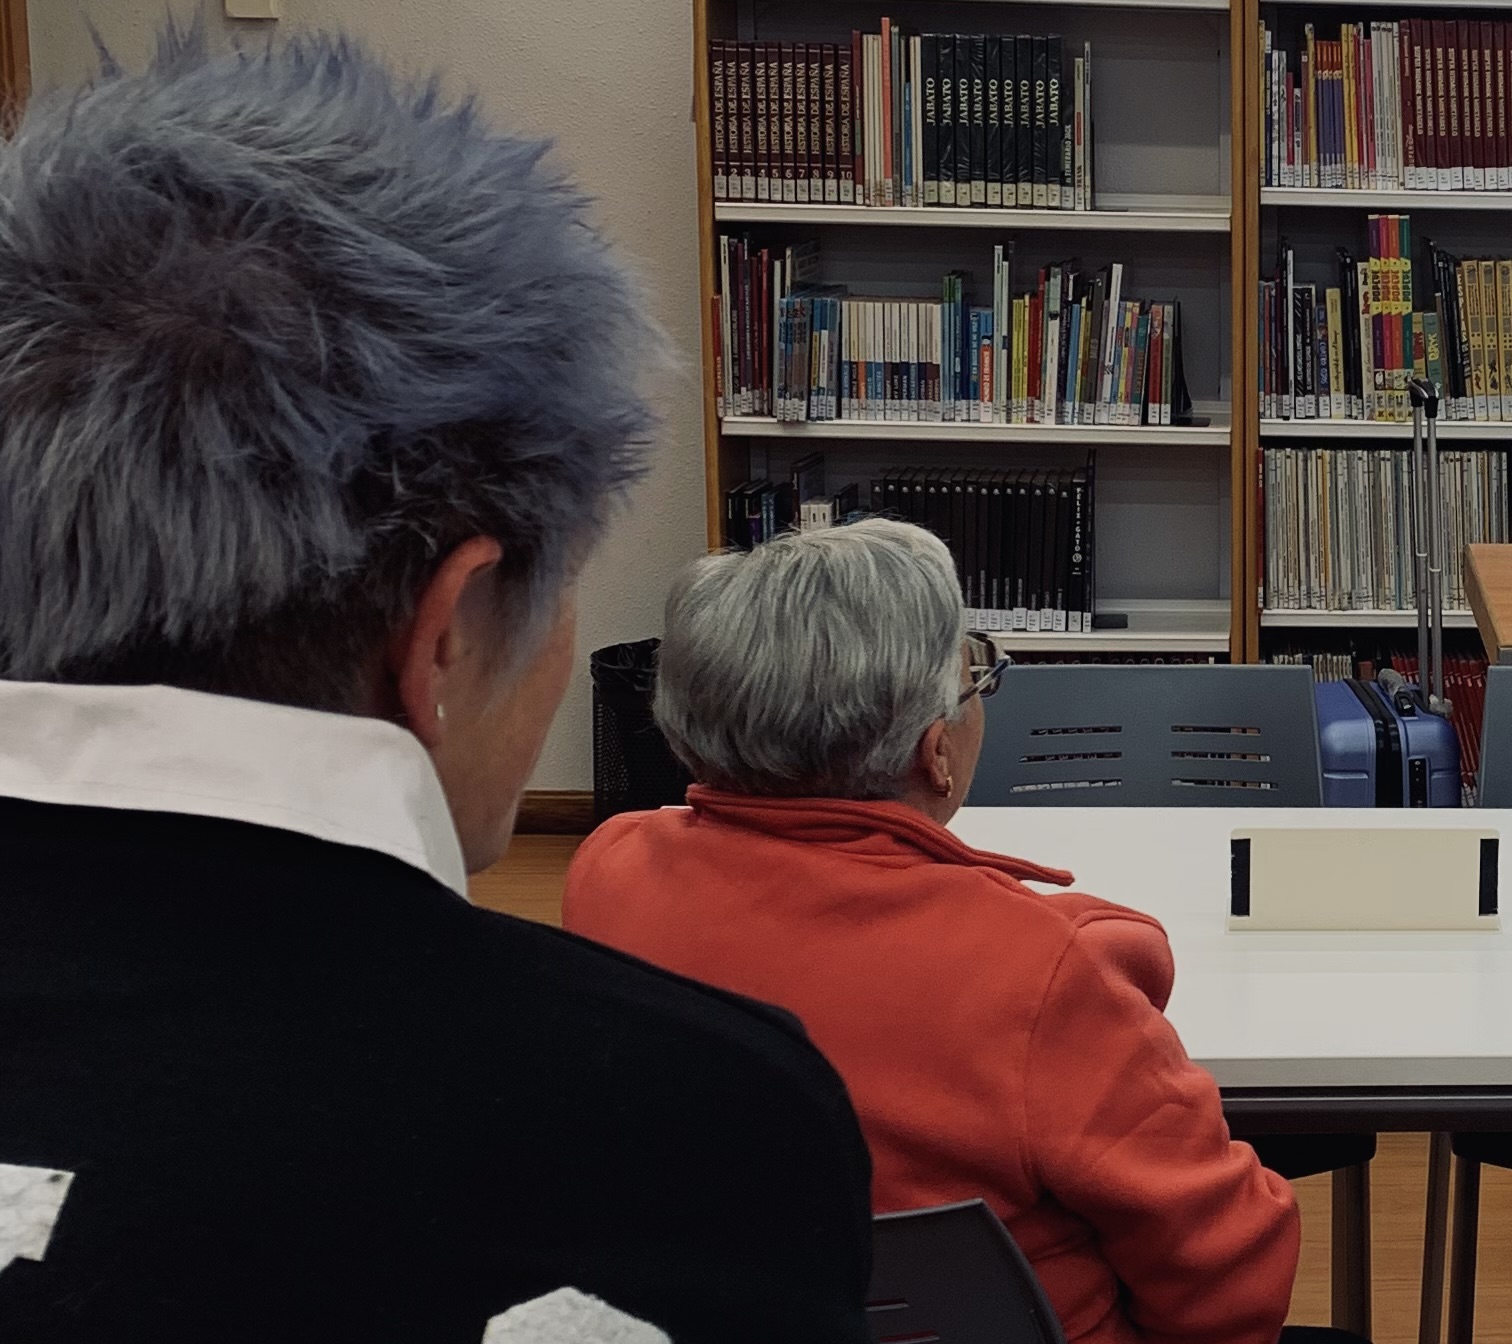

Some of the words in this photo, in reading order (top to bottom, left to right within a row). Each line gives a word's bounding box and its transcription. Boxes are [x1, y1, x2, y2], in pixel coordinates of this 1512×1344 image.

[713, 60, 723, 97] ESPAÑA
[726, 61, 736, 98] ESPAÑA
[740, 62, 750, 98] ESPAÑA
[755, 62, 766, 98] ESPAÑA
[768, 62, 778, 98] ESPAÑA
[782, 62, 793, 98] ESPAÑA
[795, 63, 805, 99] ESPAÑA
[809, 63, 820, 99] ESPAÑA
[823, 64, 834, 100] ESPAÑA
[839, 65, 850, 100] ESPAÑA
[715, 99, 723, 112] DE
[728, 100, 737, 113] DE
[742, 100, 751, 113] DE
[757, 100, 766, 114] DE
[771, 100, 779, 114] DE
[784, 101, 792, 114] DE
[797, 101, 806, 114] DE
[811, 102, 819, 114] DE
[825, 102, 834, 115] DE
[841, 103, 849, 116] DE
[926, 78, 935, 126] JABATO
[942, 79, 952, 126] JABATO
[959, 79, 968, 126] JABATO
[973, 79, 983, 126] JABATO
[989, 79, 998, 126] JABATO
[1004, 80, 1013, 127] JABATO
[1020, 80, 1029, 128] JABATO
[1035, 80, 1045, 128] JABATO
[1050, 79, 1059, 126] JABATO
[715, 115, 724, 152] HISTORIA
[729, 116, 738, 152] HISTORIA
[743, 116, 752, 153] HISTORIA
[758, 116, 767, 153] HISTORIA
[771, 116, 779, 153] HISTORIA
[784, 116, 793, 153] HISTORIA
[797, 116, 806, 154] HISTORIA
[811, 117, 820, 154] HISTORIA
[826, 116, 834, 155] HISTORIA
[841, 118, 850, 155] HISTORIA
[759, 170, 765, 178] 4
[785, 170, 792, 178] 6
[800, 170, 805, 178] 7
[813, 170, 819, 178] 8
[827, 171, 833, 179] 9
